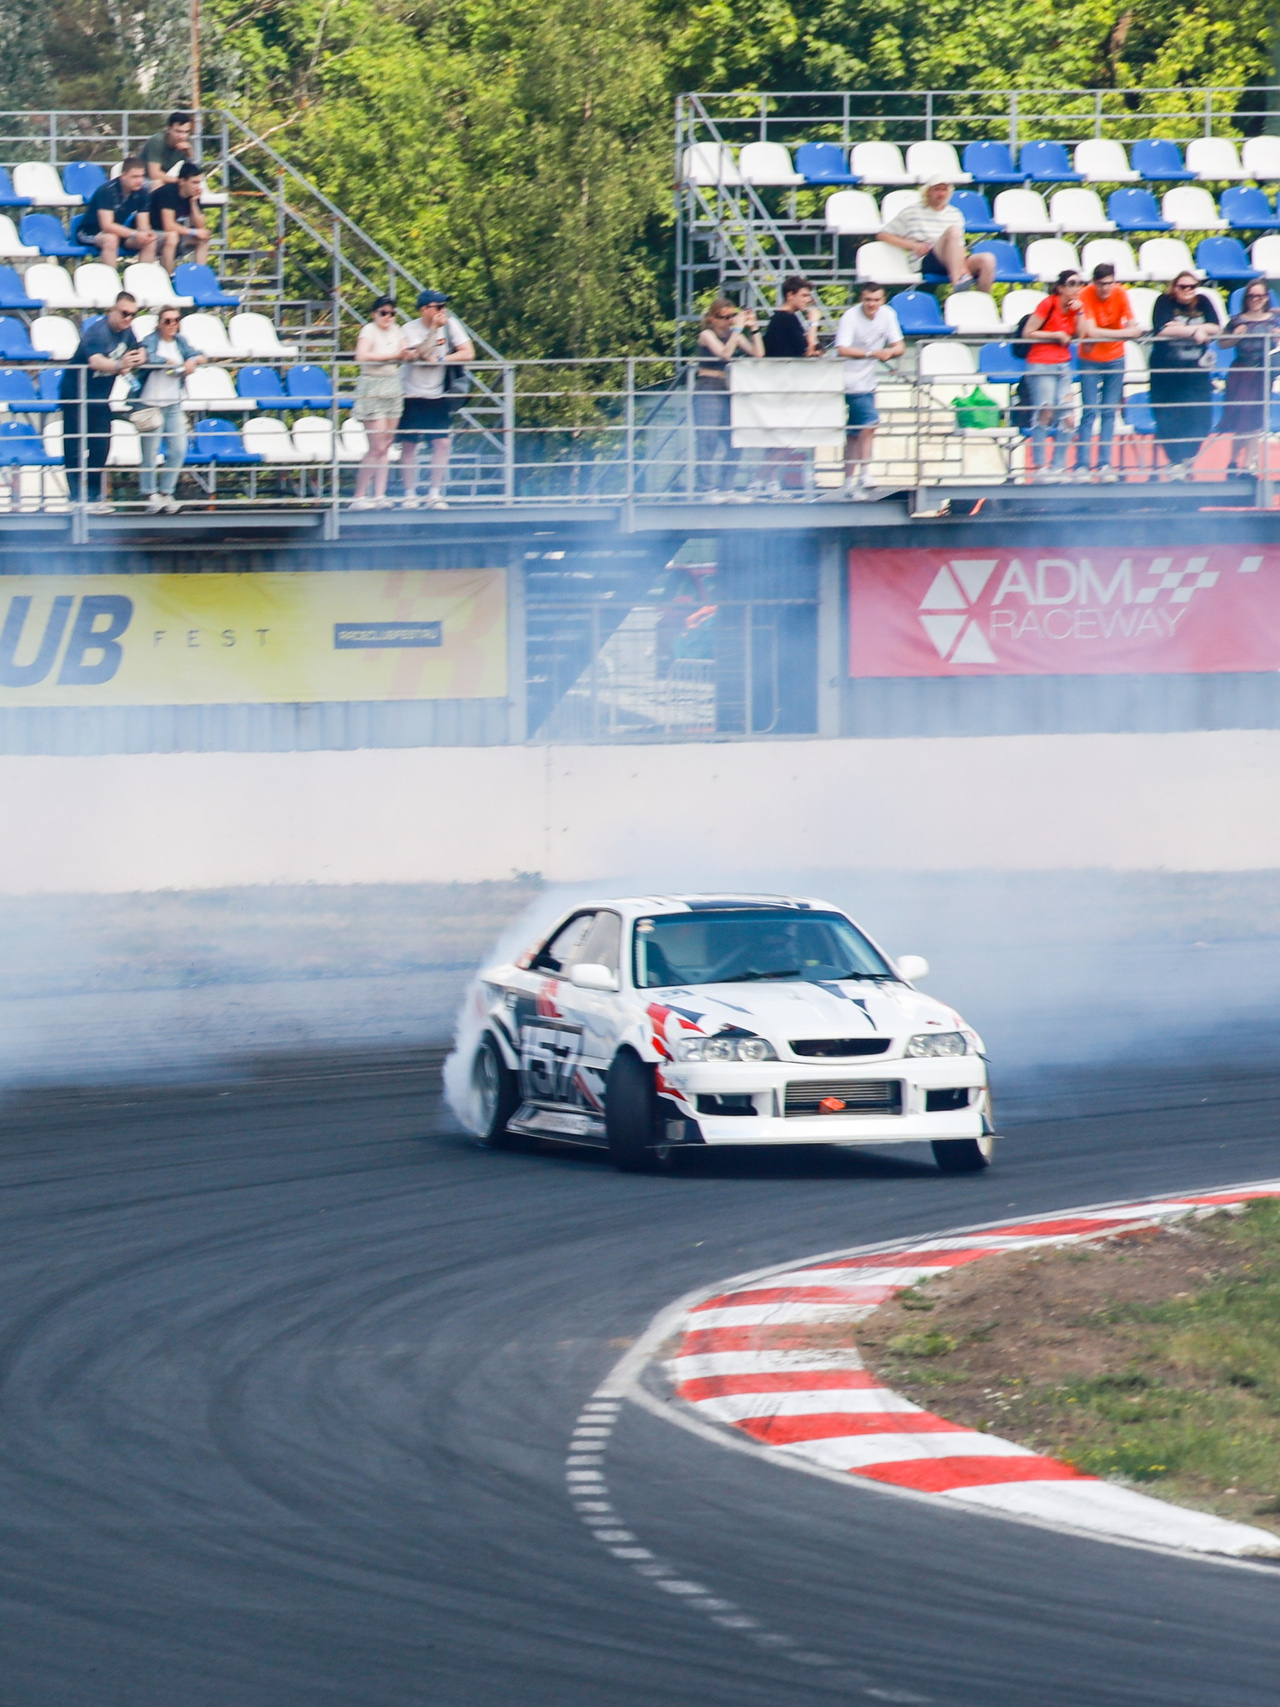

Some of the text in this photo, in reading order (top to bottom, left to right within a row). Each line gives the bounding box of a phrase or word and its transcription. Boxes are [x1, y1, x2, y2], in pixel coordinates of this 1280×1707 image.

[991, 558, 1134, 606] ADM
[154, 627, 271, 648] FEST
[989, 606, 1188, 640] RACEWAY
